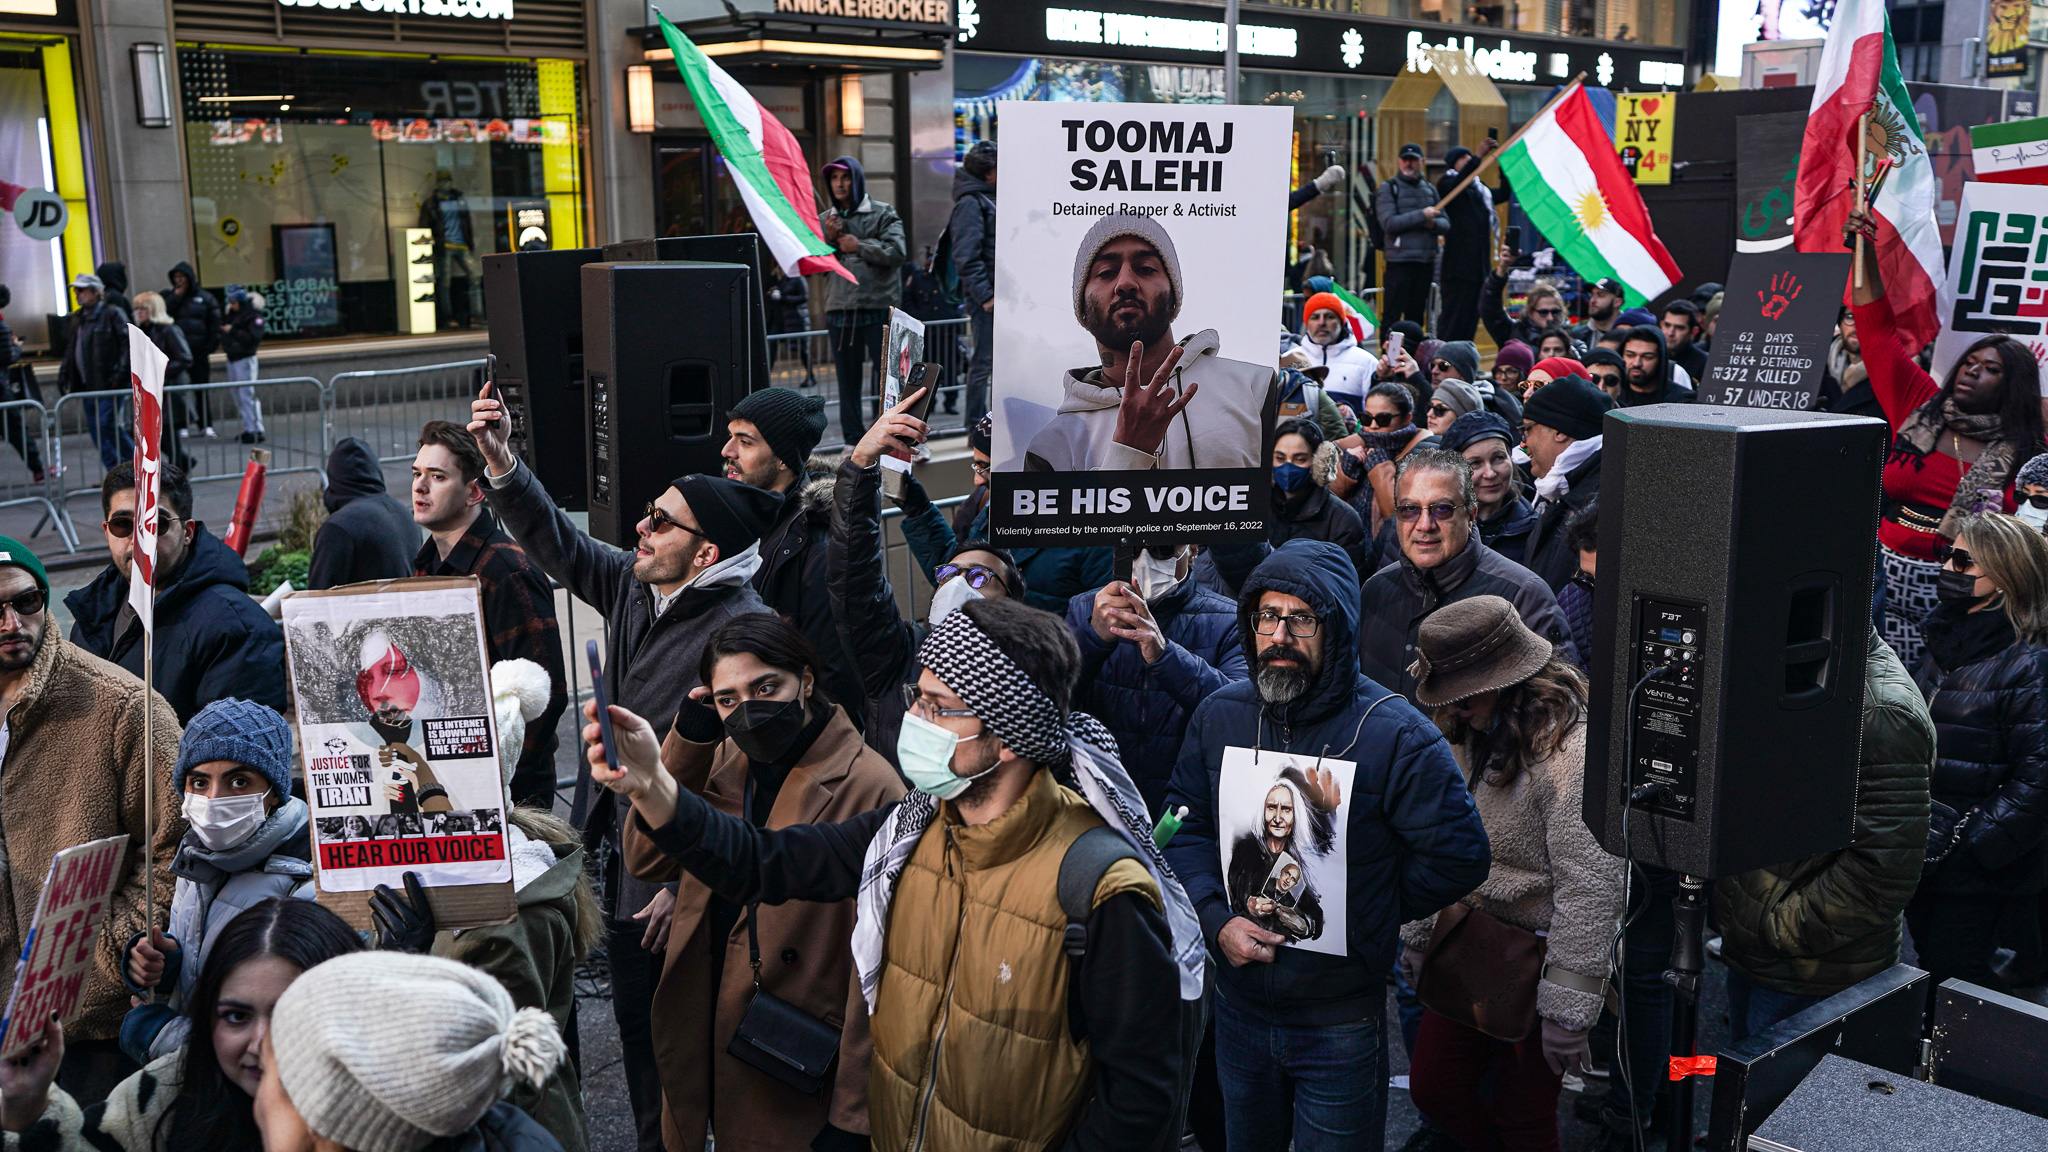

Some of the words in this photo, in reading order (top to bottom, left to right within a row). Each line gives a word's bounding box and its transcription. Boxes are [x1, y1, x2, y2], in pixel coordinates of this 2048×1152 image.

[1629, 98, 1638, 117] I
[1061, 120, 1234, 154] TOOMAJ
[1624, 119, 1661, 142] NY
[1069, 158, 1223, 192] SALEHI
[23, 200, 63, 228] JD
[1053, 202, 1114, 216] Detained
[1119, 202, 1168, 219] Rapper
[1173, 203, 1183, 216] &
[1188, 203, 1236, 217] Activist
[1739, 332, 1754, 342] 62
[1765, 332, 1794, 343] DAYS
[1731, 344, 1752, 353] 144
[1762, 345, 1799, 355] CITIES
[1729, 355, 1756, 366] 16K+
[1760, 356, 1812, 369] DETAINED
[1755, 369, 1802, 385] KILLED
[1723, 387, 1744, 405] 57
[1013, 489, 1059, 515] BE
[1071, 487, 1131, 515] HIS
[1143, 485, 1250, 513] VOICE
[996, 526, 1033, 536] Violently
[1034, 526, 1070, 535] arrested
[1072, 525, 1083, 535] by
[1084, 525, 1098, 533] the
[1100, 523, 1134, 534] morality
[1135, 523, 1161, 534] police
[1162, 524, 1174, 532] on
[1176, 522, 1222, 533] September
[1224, 522, 1238, 531] 16,
[1240, 521, 1263, 530] 2022
[1661, 612, 1682, 621] FBT
[1644, 688, 1675, 700] VENTIS
[426, 721, 444, 731] THE
[444, 719, 485, 729] INTERNET
[428, 730, 438, 739] IS
[438, 728, 466, 738] DOWN
[467, 727, 487, 737] AND
[429, 738, 446, 746] THEY
[429, 745, 450, 756] THE
[310, 756, 350, 771] JUSTICE
[351, 755, 370, 769] FOR
[312, 773, 331, 786] THE
[332, 771, 371, 785] WOMEN
[320, 786, 368, 807] IRAN
[327, 843, 384, 868] HEAR
[389, 841, 431, 865] OUR
[435, 837, 496, 862] VOICE
[46, 842, 119, 917] WOMAN
[22, 901, 102, 993] LIFE
[4, 968, 85, 1054] FREEDOM
